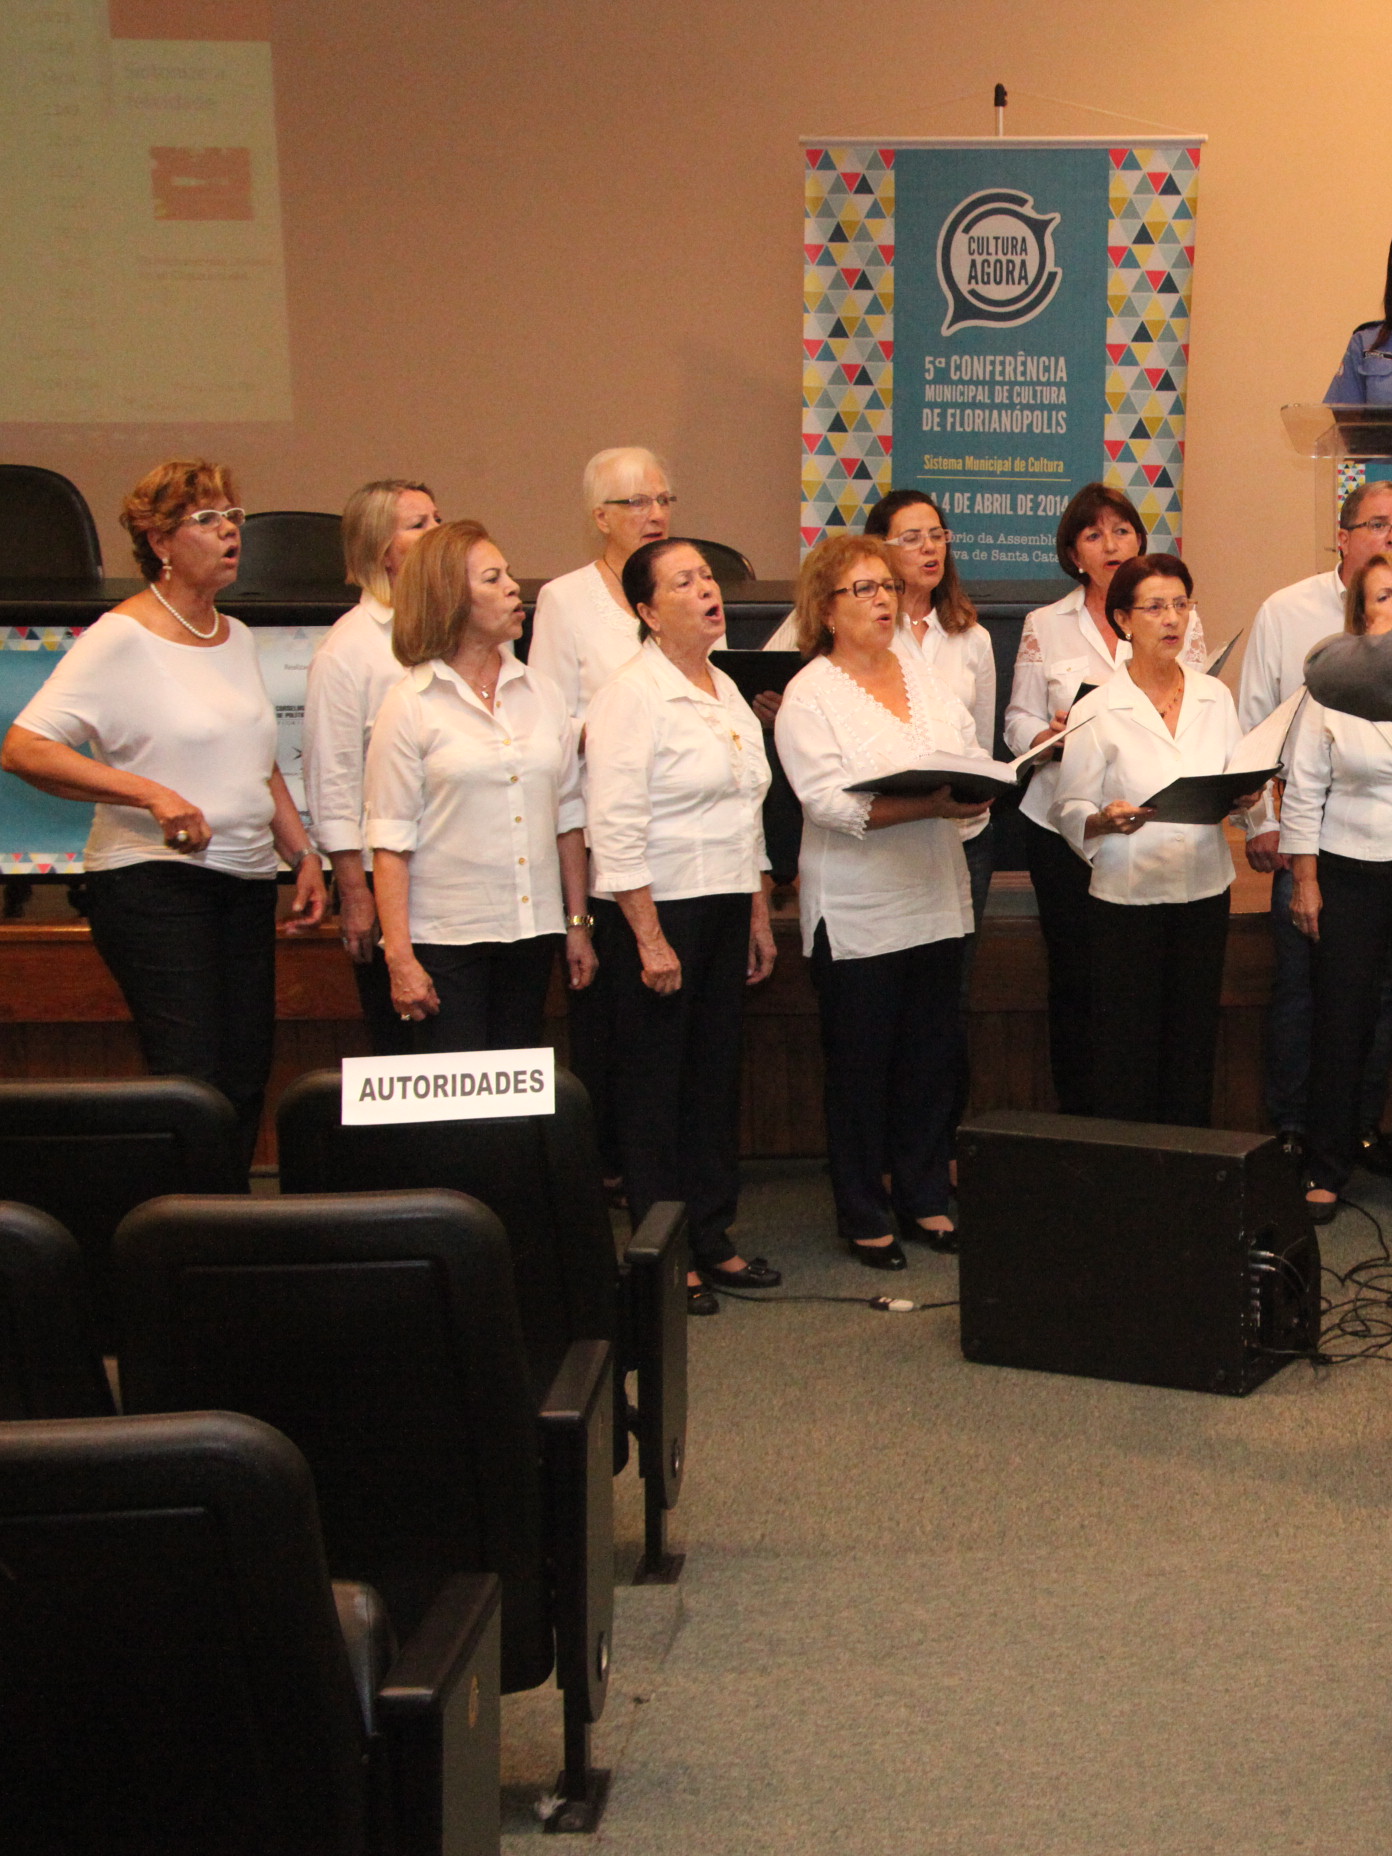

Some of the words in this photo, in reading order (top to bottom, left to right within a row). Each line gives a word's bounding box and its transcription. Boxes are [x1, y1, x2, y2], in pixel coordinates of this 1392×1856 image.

[967, 235, 1028, 256] CULTURA
[967, 258, 1029, 286] AGORA
[950, 351, 1068, 382] CONFERÊNCIA
[925, 384, 991, 403] MUNICIPAL
[994, 385, 1010, 404] DE
[1013, 386, 1067, 405] CULTURA
[922, 408, 941, 432] DE
[946, 405, 1067, 434] FLORIANÓPOLIS
[923, 454, 963, 470] Sistema
[965, 455, 1012, 474] Municipal
[1014, 457, 1026, 472] de
[1028, 457, 1064, 473] Cultura
[942, 492, 951, 513] 4
[954, 492, 971, 514] DE
[974, 493, 1013, 515] ABRIL
[1017, 494, 1034, 516] DE
[1037, 494, 1069, 516] 2014
[978, 532, 994, 544] da
[972, 549, 988, 561] de
[991, 549, 1029, 563] Santa
[358, 1068, 545, 1102] AUTORIDADES
